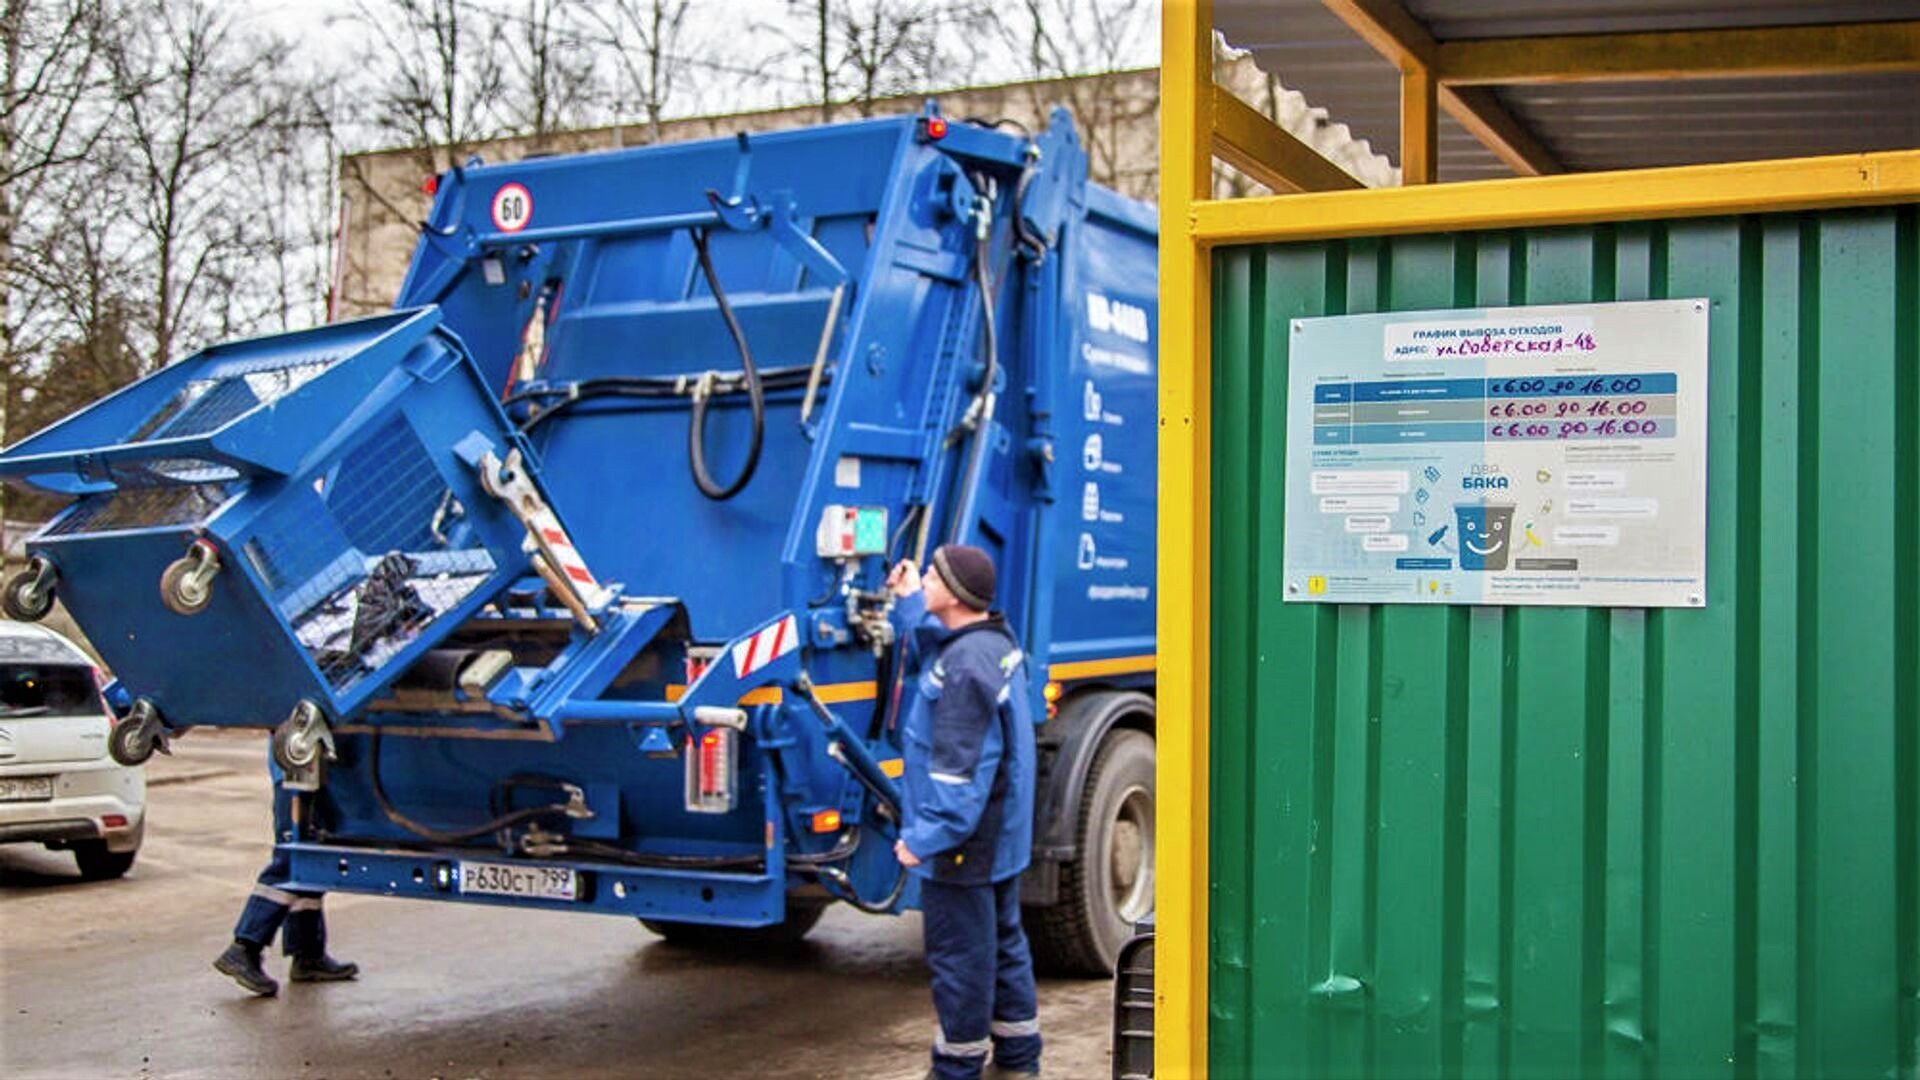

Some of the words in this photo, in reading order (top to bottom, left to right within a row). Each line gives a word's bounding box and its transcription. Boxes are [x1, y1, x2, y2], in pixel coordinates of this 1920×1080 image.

[502, 196, 523, 221] 60
[1413, 330, 1457, 339] ГРАФИК
[1459, 328, 1506, 338] ВЫВОЗА
[1509, 325, 1563, 336] ОТХОДОВ
[1503, 379, 1545, 393] 6.00
[1580, 378, 1642, 393] 16.00
[1504, 402, 1547, 417] 6.00
[1586, 401, 1647, 417] 16.00
[1507, 423, 1549, 437] 6.00
[1593, 419, 1657, 437] 16.00
[1462, 477, 1509, 489] БАКА
